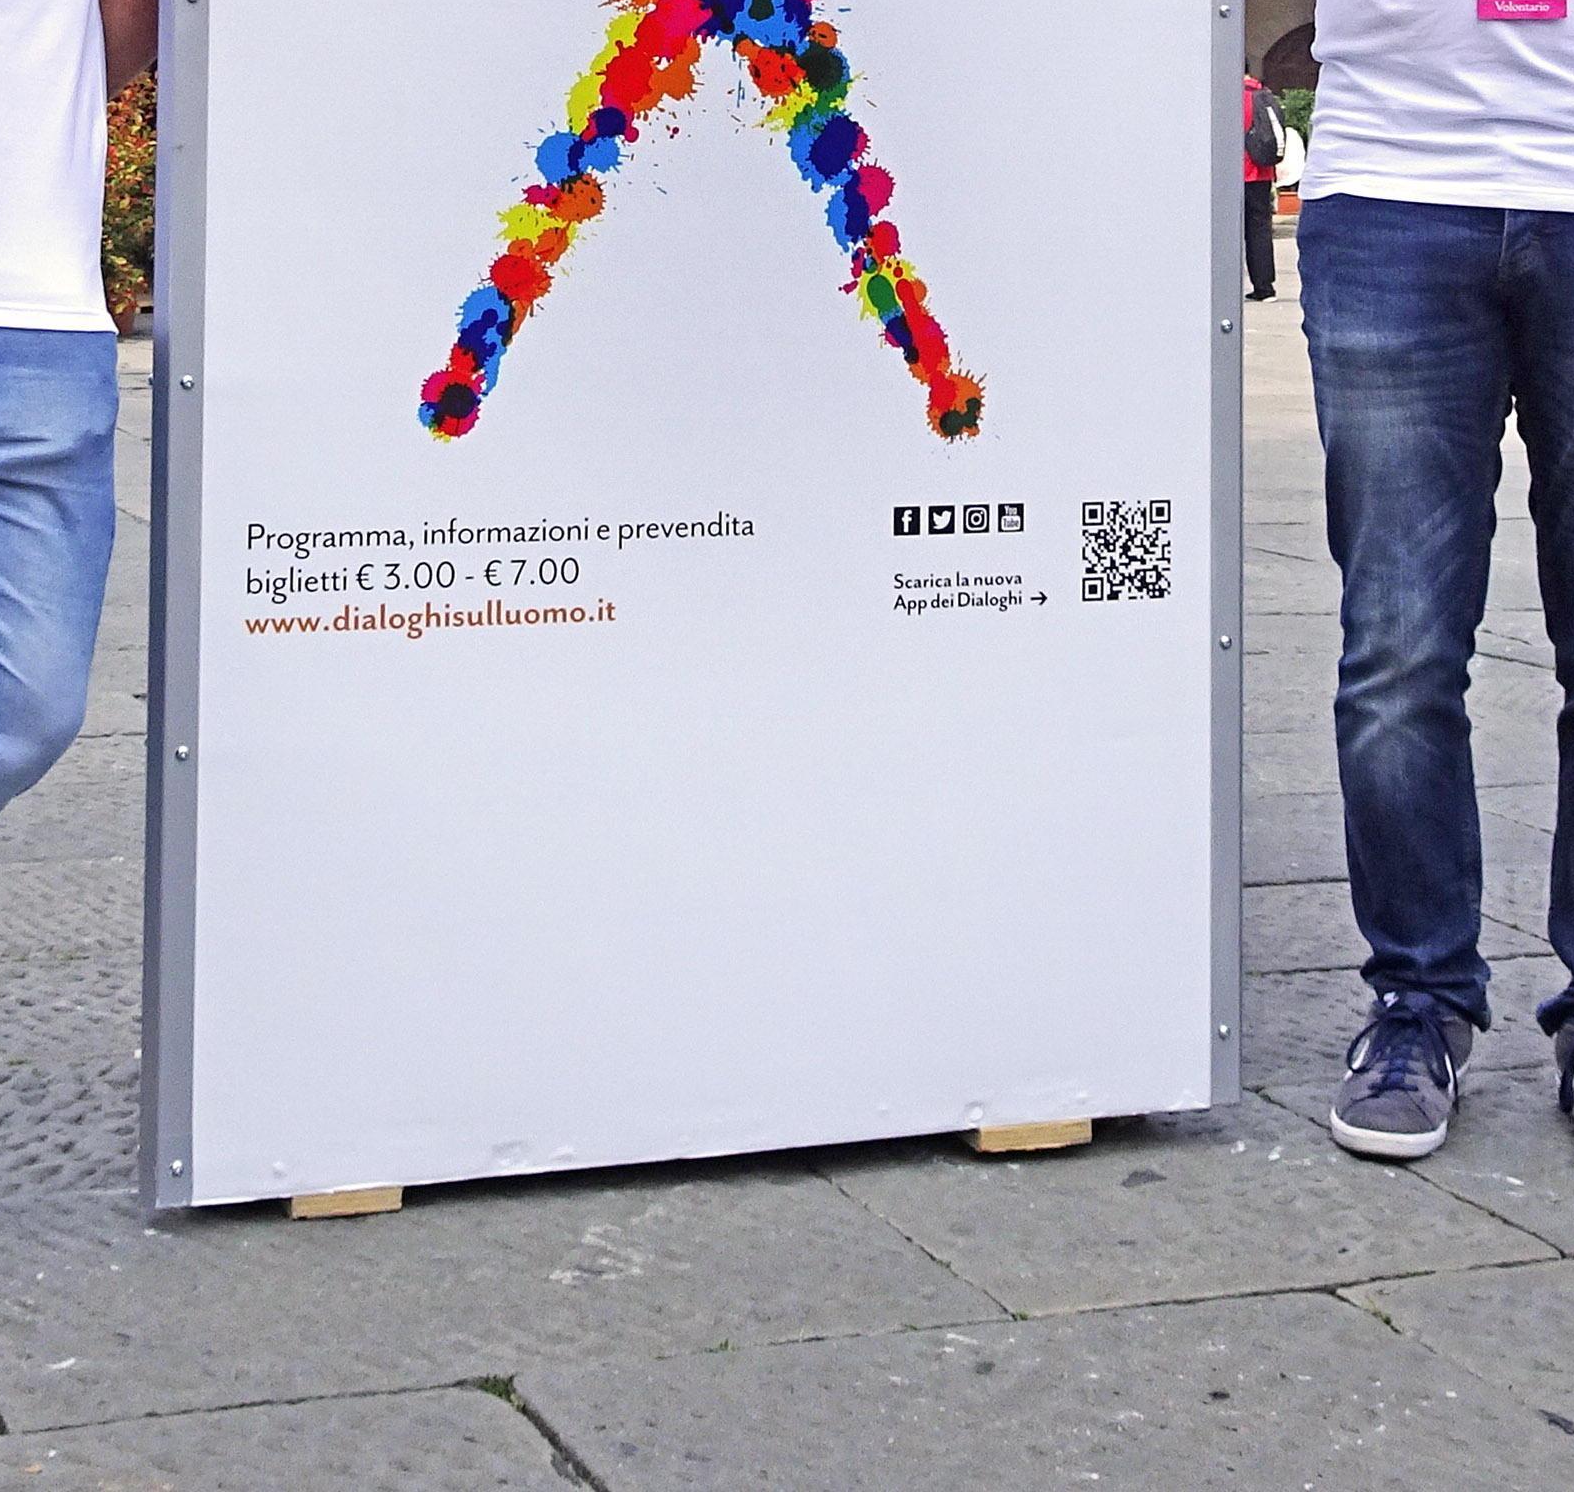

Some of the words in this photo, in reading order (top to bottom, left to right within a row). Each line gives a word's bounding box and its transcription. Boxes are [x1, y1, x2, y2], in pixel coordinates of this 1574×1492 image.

[1495, 0, 1550, 12] Volontario
[248, 523, 414, 559] Programma,
[424, 515, 589, 547] informazioni
[597, 524, 610, 540] e
[619, 510, 754, 550] prevendita
[247, 566, 347, 604] biglietti
[384, 561, 455, 590] 3.00
[510, 557, 579, 585] 7.00
[894, 573, 951, 589] Scarica
[956, 571, 969, 587] la
[974, 574, 1022, 586] nuova
[245, 598, 616, 639] www.dialoghisulluomo.it
[893, 594, 927, 615] App
[931, 593, 954, 609] dei
[958, 590, 1022, 612] Dialoghi
